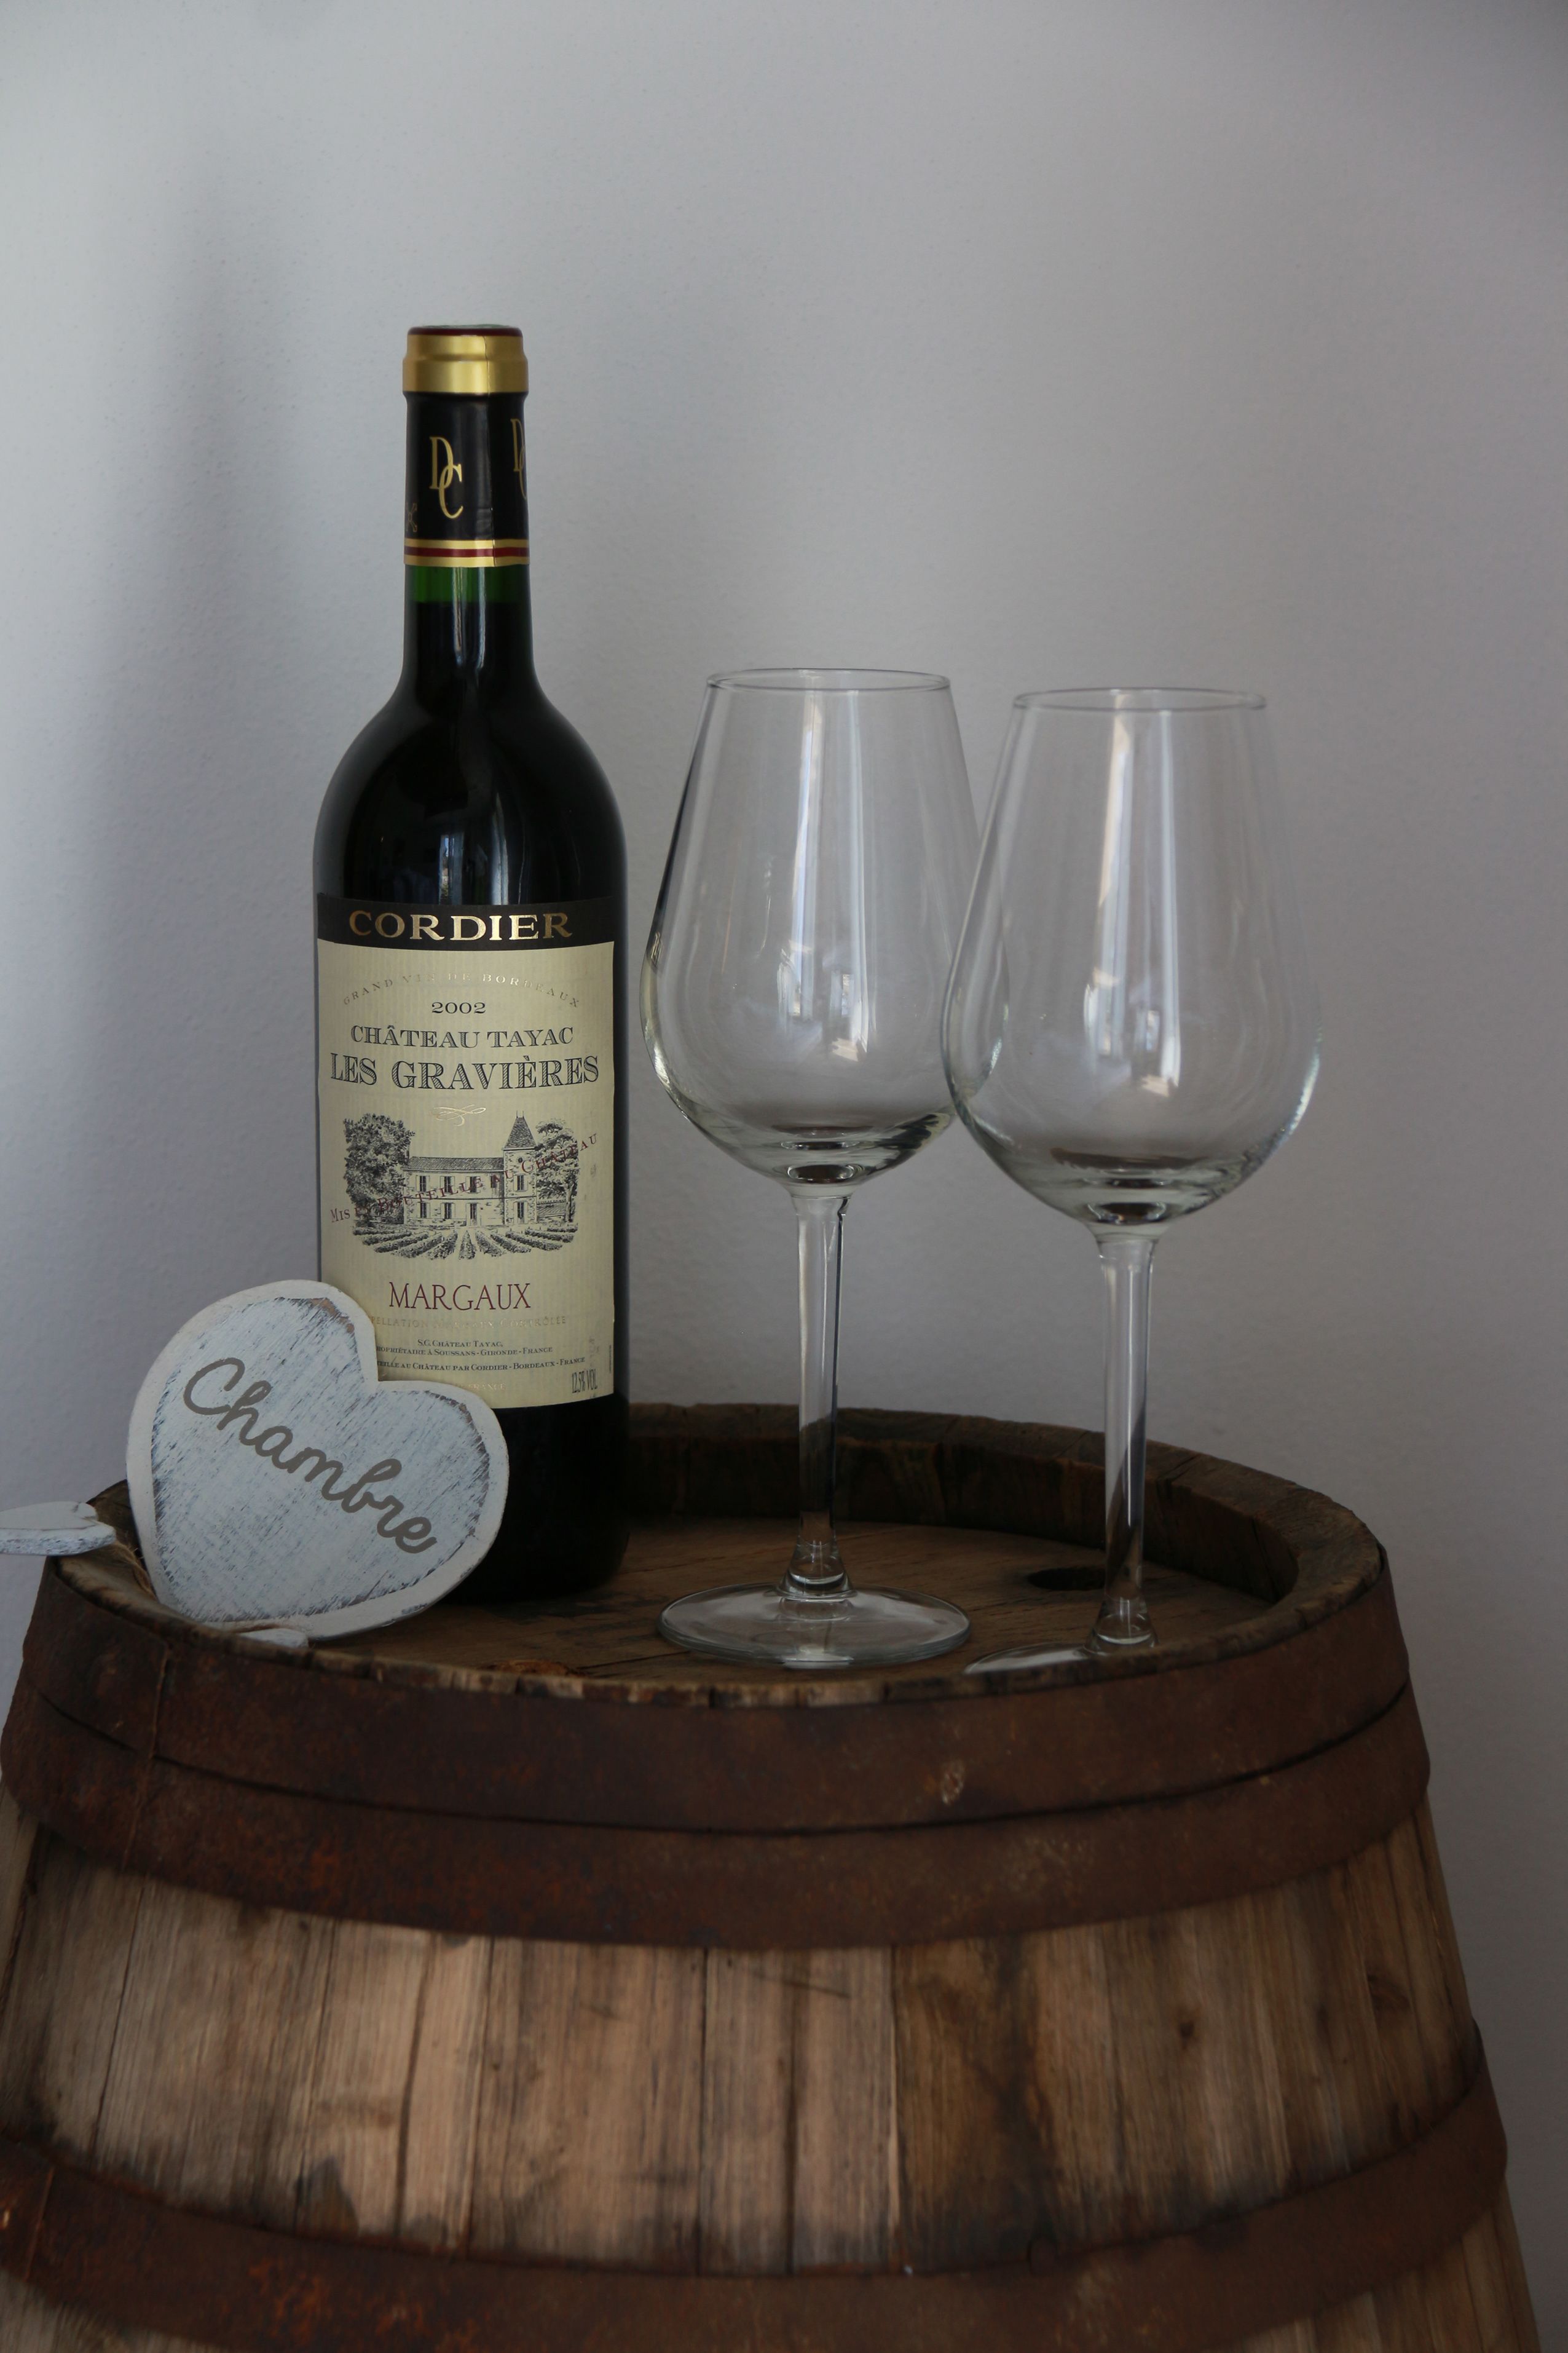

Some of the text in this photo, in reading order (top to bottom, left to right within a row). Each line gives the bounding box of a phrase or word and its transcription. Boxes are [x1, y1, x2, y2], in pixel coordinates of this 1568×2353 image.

[349, 909, 573, 941] CORDIER
[343, 973, 580, 1008] GRAND VIN DE BORDEAUX
[431, 1002, 486, 1014] 2002
[351, 1024, 574, 1048] CHÂTEAU TAYAC
[330, 1053, 599, 1090] LES GRAVIÈRES
[330, 1208, 350, 1223] MIS
[388, 1281, 531, 1311] MARGAUX
[513, 1361, 555, 1370] BORDEAUX
[559, 1356, 586, 1366] FRANCE
[183, 1357, 438, 1554] Chambre
